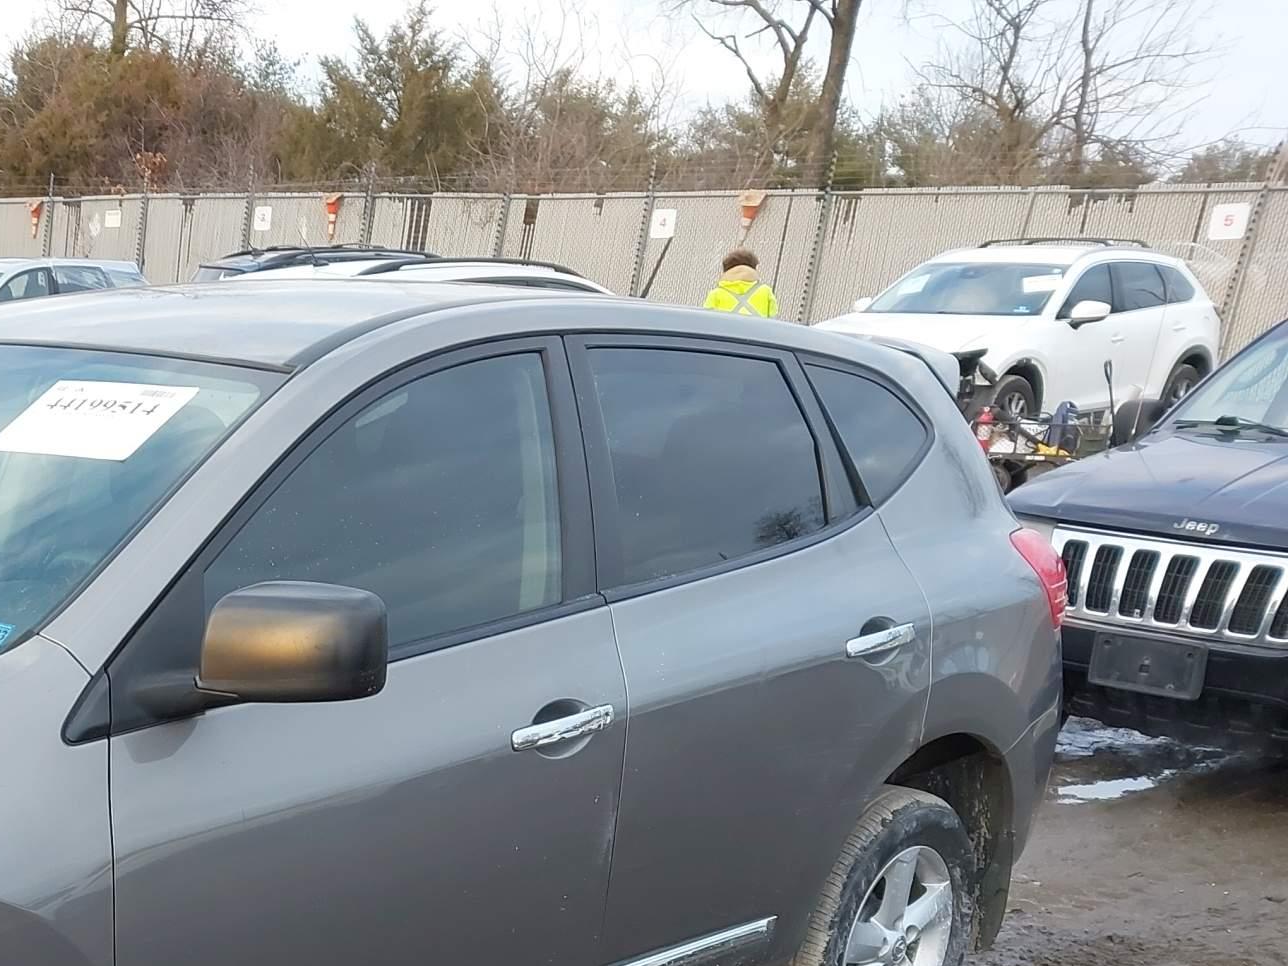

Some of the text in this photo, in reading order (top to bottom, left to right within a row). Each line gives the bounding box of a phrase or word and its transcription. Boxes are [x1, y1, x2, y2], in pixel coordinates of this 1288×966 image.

[1223, 214, 1235, 227] 5
[46, 397, 161, 416] 44199514
[1172, 517, 1220, 536] Jeep
